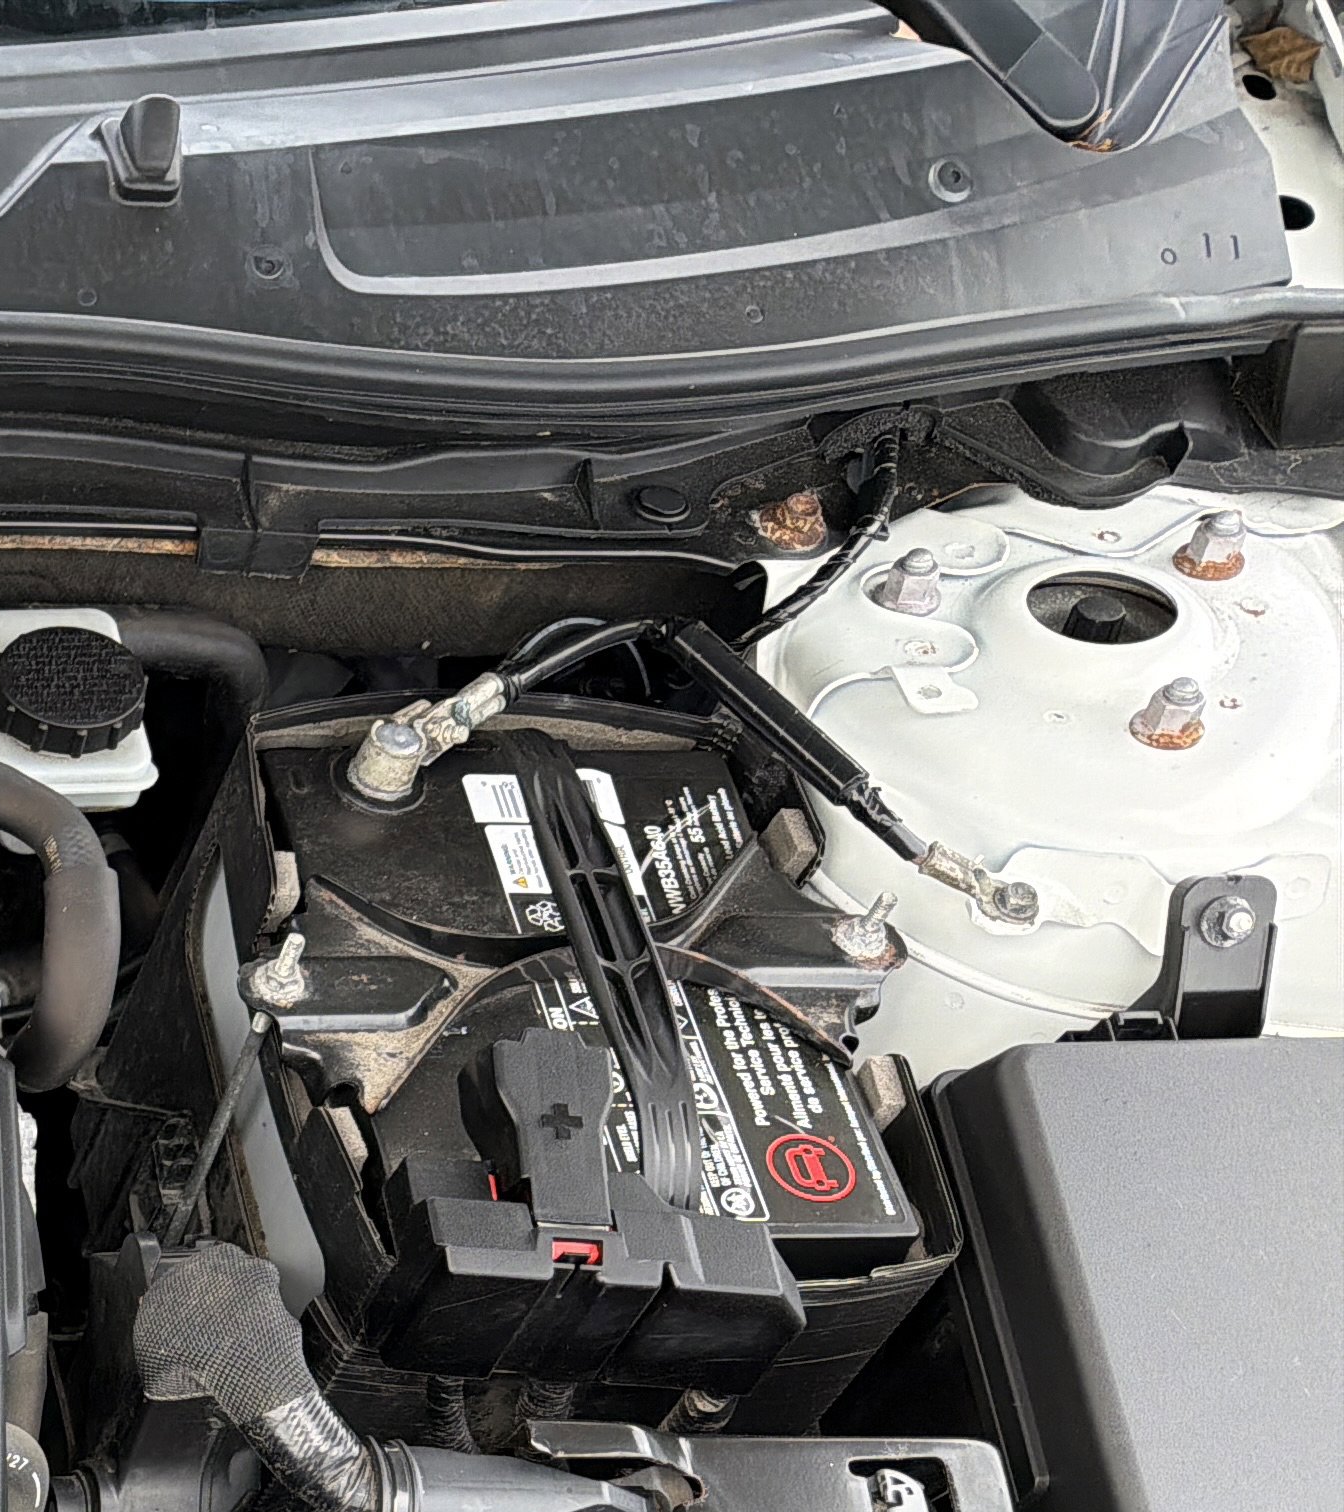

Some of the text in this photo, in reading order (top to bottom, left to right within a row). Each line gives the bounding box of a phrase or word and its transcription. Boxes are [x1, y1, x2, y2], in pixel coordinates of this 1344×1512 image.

[687, 826, 706, 845] 55
[548, 1007, 569, 1032] ON
[705, 988, 731, 1030] Profes
[720, 1029, 740, 1051] the
[757, 1021, 775, 1042] les
[729, 1050, 748, 1072] for
[766, 1040, 791, 1074] pour
[746, 1048, 776, 1098] Service
[787, 1049, 815, 1096] service
[736, 1071, 770, 1128] Powered
[806, 1096, 824, 1115] de
